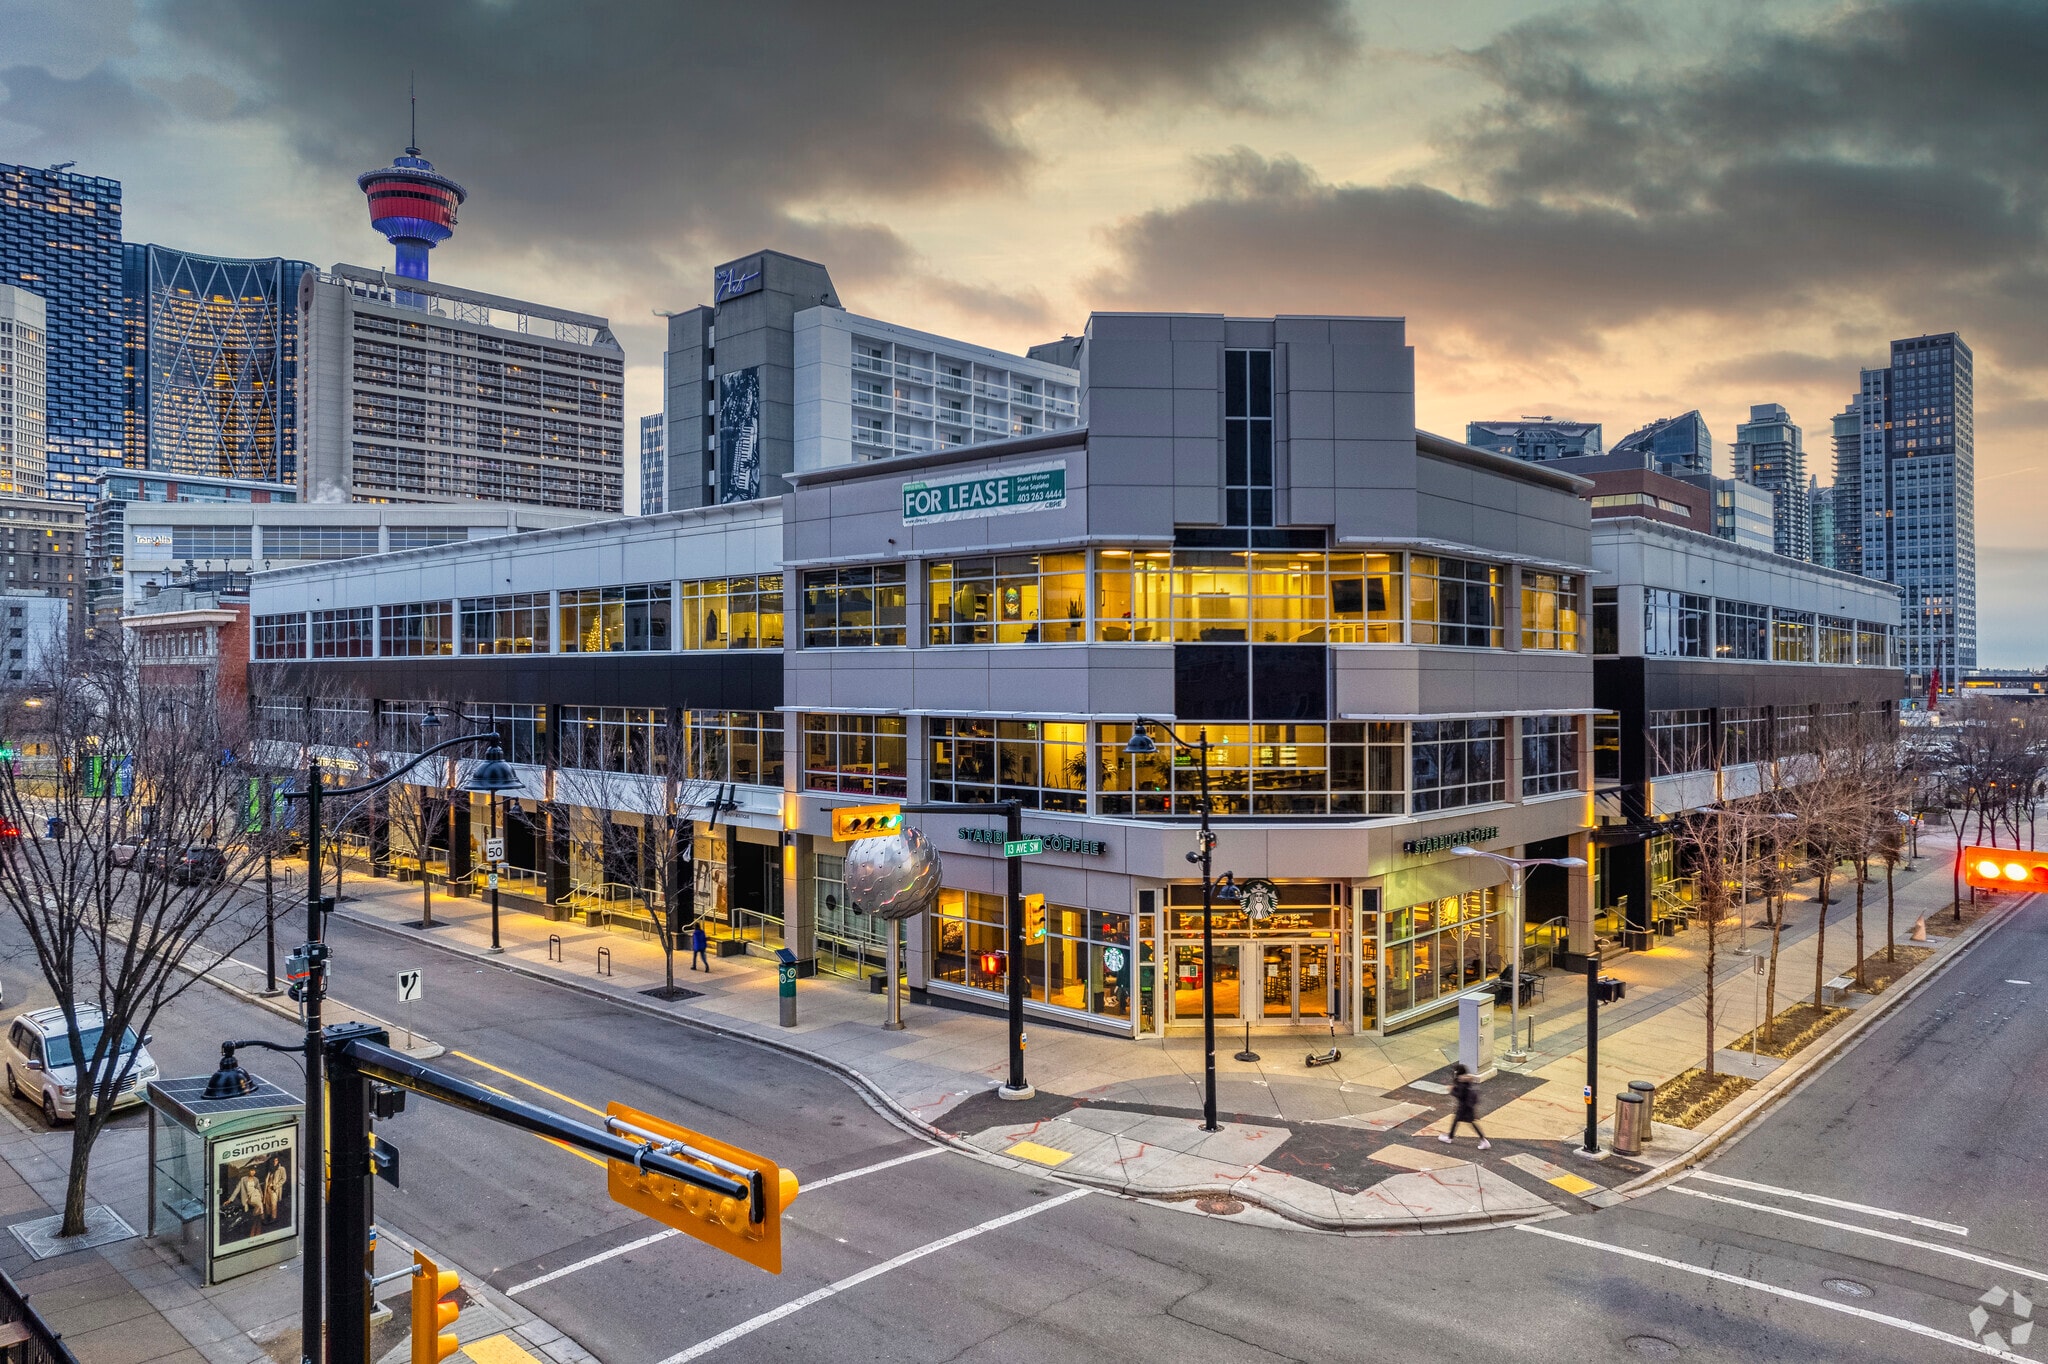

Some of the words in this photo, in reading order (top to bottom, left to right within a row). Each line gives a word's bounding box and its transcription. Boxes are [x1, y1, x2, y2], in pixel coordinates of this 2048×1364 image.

[905, 489, 942, 515] FOR
[948, 480, 1009, 510] LEASE
[1017, 493, 1030, 502] 403
[1031, 491, 1044, 501] 263
[1045, 489, 1062, 499] 4444
[1007, 844, 1014, 854] 13
[1016, 843, 1027, 853] AVE
[1029, 842, 1039, 852] SW
[1043, 836, 1100, 855] COFFEE
[1415, 831, 1468, 854] STARBUCKS
[1469, 826, 1499, 842] COFFEE
[488, 847, 502, 858] 50
[232, 1137, 289, 1157] simons
